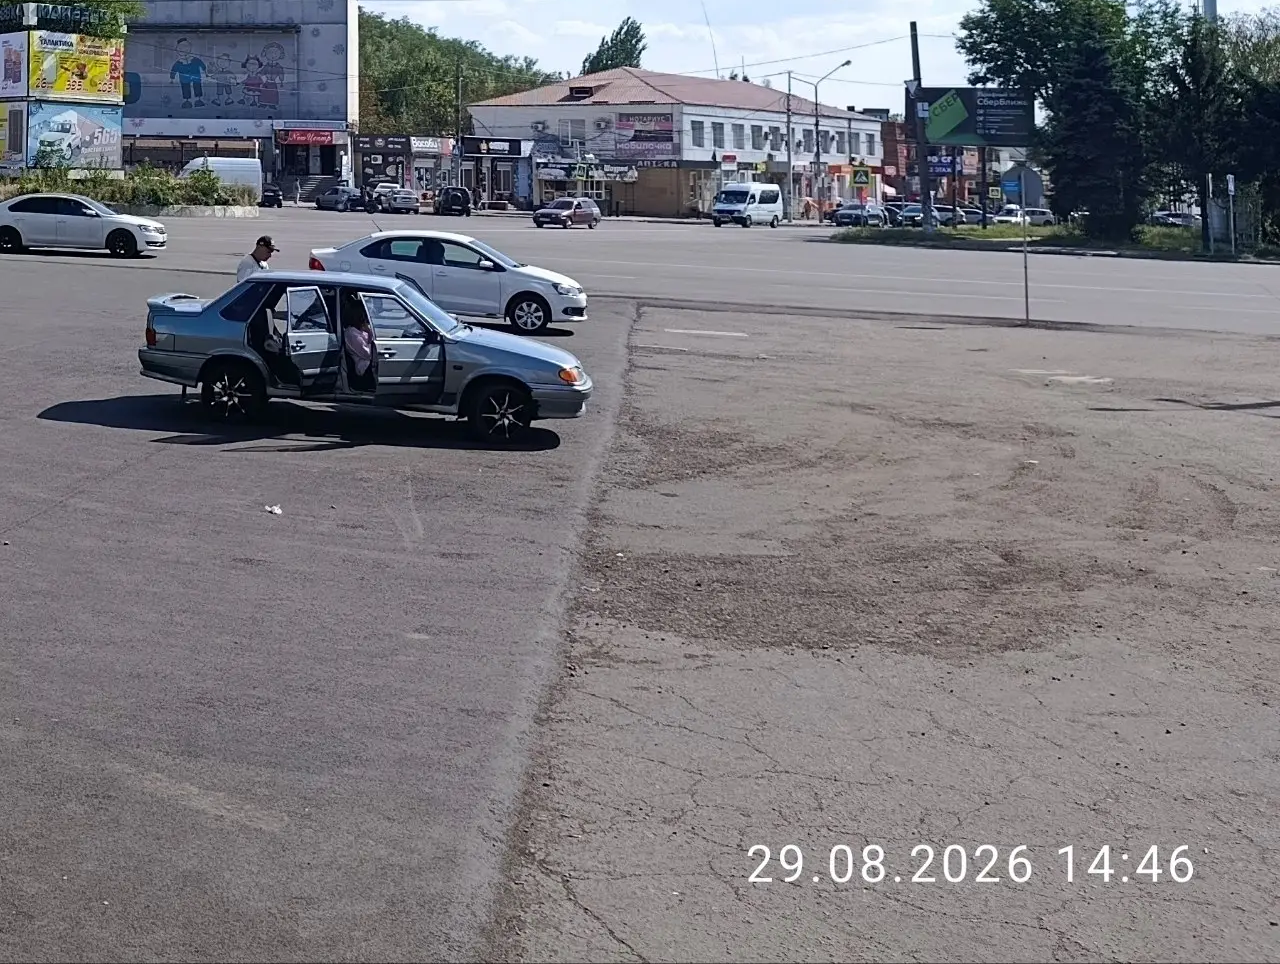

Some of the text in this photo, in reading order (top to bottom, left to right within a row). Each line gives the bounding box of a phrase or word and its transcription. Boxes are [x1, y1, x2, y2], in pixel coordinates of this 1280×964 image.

[932, 91, 960, 117] СБЕР
[629, 115, 666, 123] НОТАРИУС
[636, 160, 678, 168] АПТЕКА
